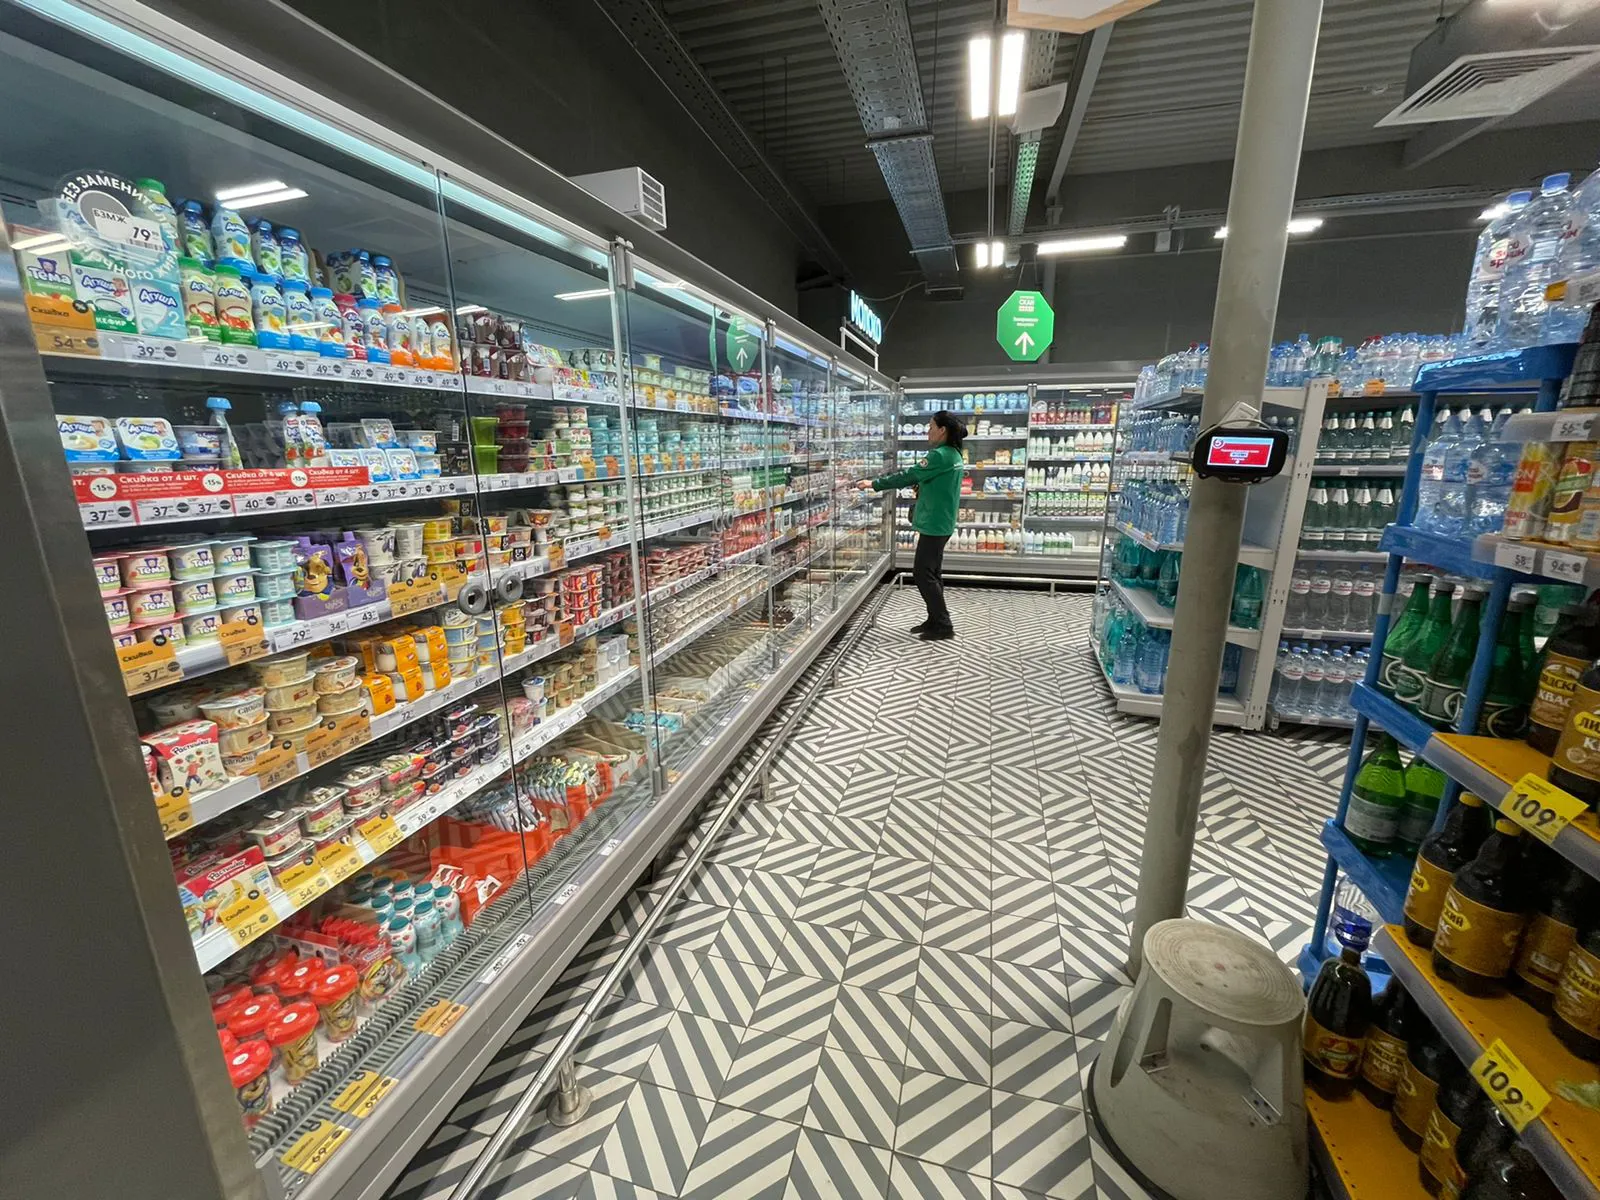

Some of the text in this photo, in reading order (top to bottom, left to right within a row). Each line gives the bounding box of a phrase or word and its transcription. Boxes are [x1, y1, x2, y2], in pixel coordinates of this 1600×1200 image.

[168, 311, 181, 326] 2
[53, 336, 74, 348] 54
[138, 345, 154, 357] 39
[215, 354, 228, 364] 49
[277, 361, 289, 369] 49
[316, 365, 328, 374] 49
[351, 369, 361, 377] 49
[384, 372, 394, 381] 49
[120, 475, 160, 484] Скидка
[183, 474, 199, 482] шт.
[226, 471, 257, 479] Скидка
[324, 494, 335, 502] 40
[387, 489, 395, 497] 37
[245, 500, 259, 509] 40
[286, 497, 299, 505] 40
[153, 507, 168, 517] 37
[198, 503, 212, 513] 37
[90, 511, 107, 522] 37
[362, 612, 373, 621] 43
[329, 621, 341, 632] 34
[292, 630, 306, 642] 29
[240, 646, 252, 657] 37
[142, 669, 158, 682] 37
[1512, 793, 1556, 826] 109
[1482, 1059, 1524, 1104] 109
